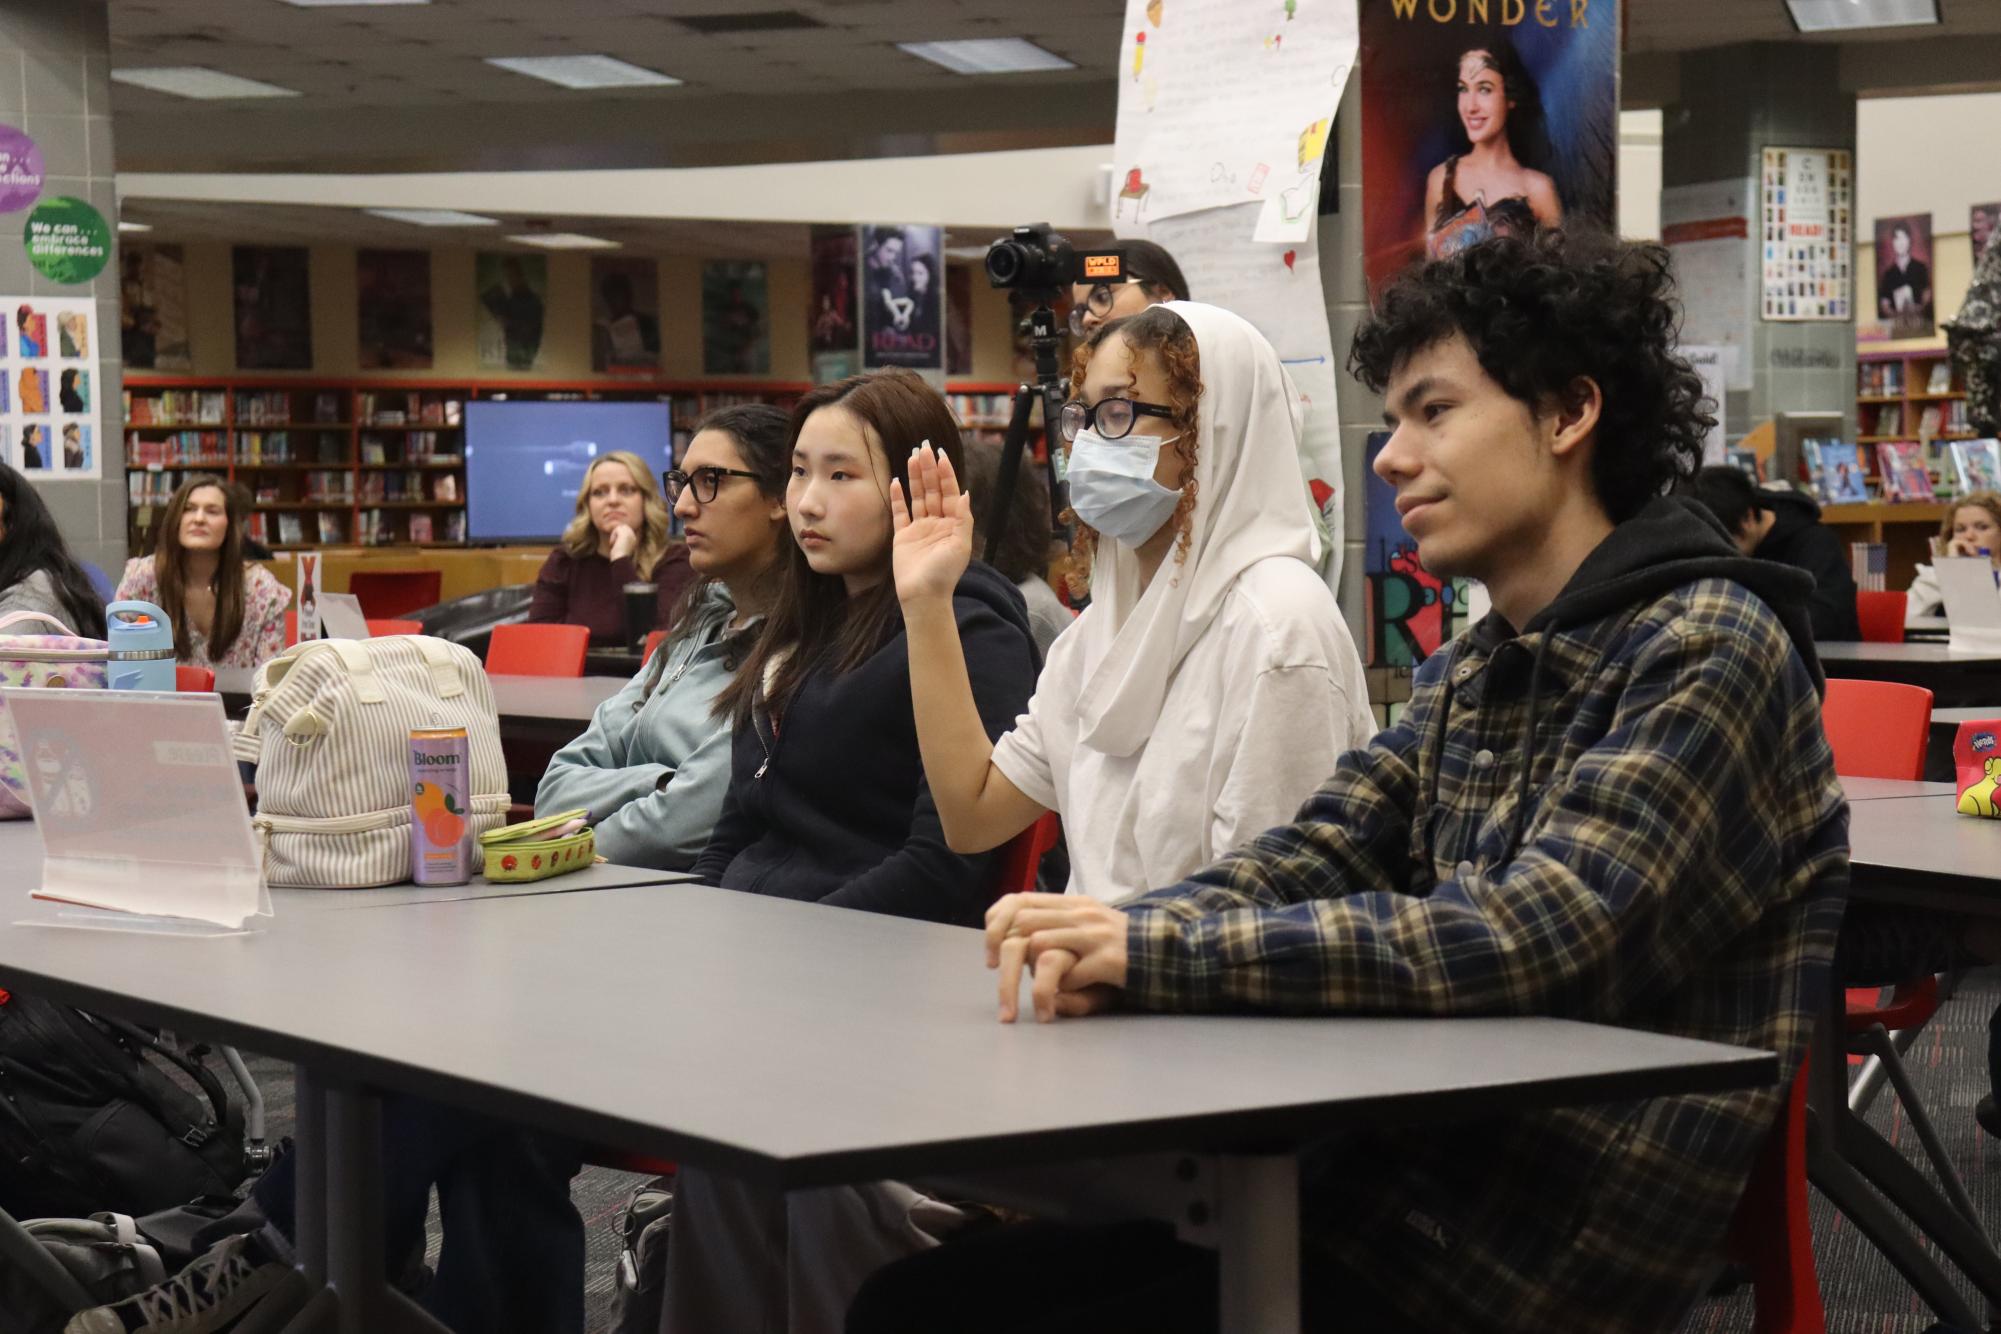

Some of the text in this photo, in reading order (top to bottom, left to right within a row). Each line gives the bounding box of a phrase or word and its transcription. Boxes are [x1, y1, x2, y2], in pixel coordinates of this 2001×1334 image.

[1391, 0, 1588, 29] WONDER
[0, 174, 40, 185] ctions
[31, 222, 51, 234] We
[32, 233, 88, 246] embrace
[32, 244, 103, 256] differences
[414, 752, 460, 766] Bloom
